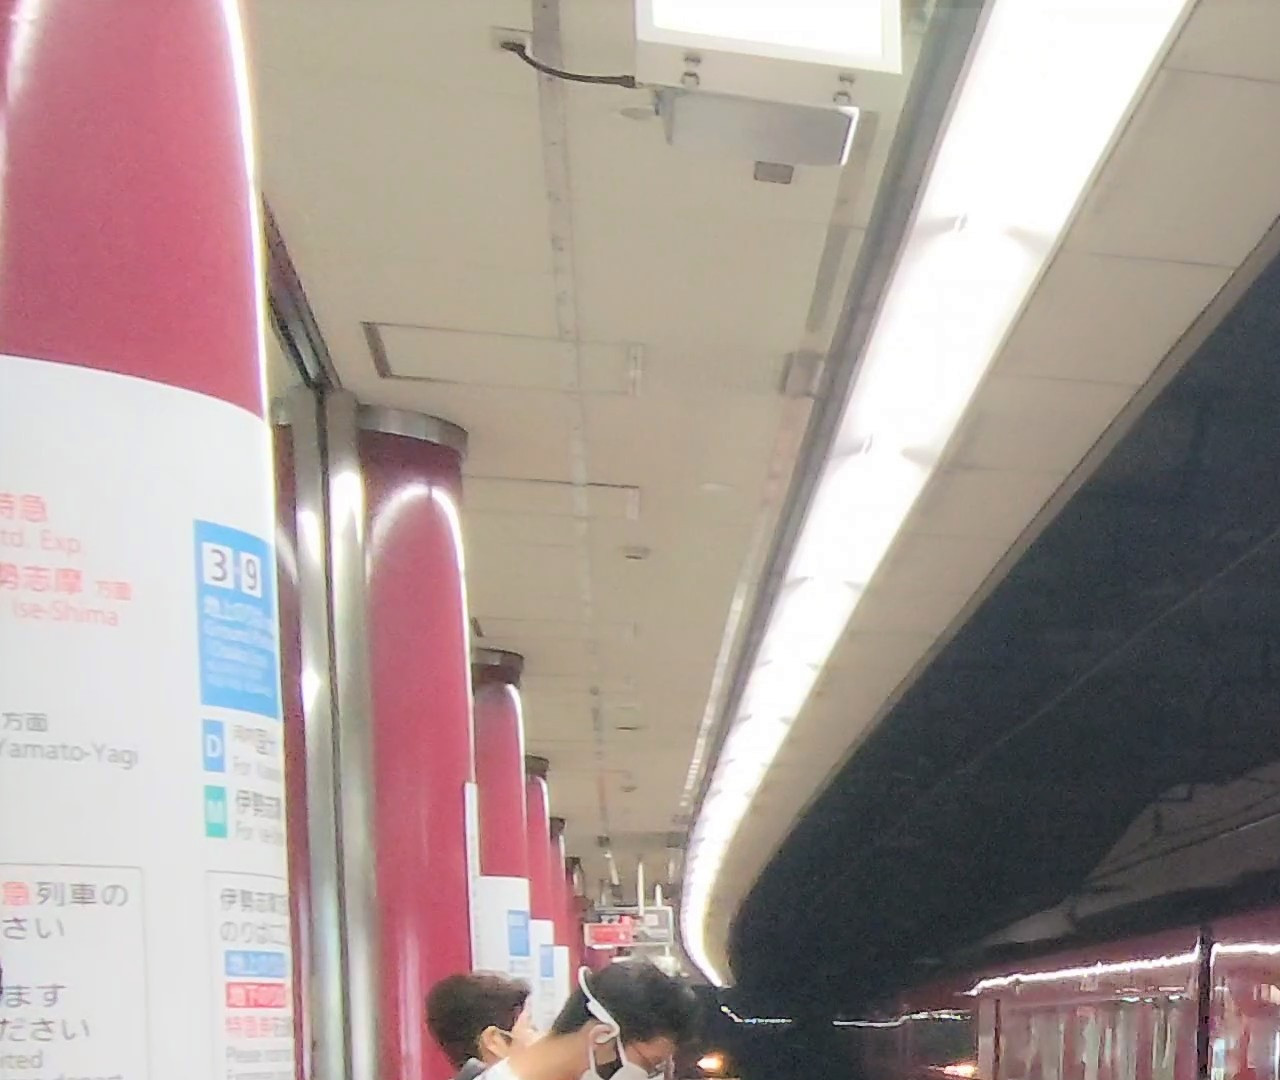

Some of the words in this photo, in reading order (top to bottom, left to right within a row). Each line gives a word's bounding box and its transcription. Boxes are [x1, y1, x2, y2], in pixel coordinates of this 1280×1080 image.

[2, 712, 48, 732] 方面
[206, 734, 221, 757] D
[2, 917, 64, 940] さい
